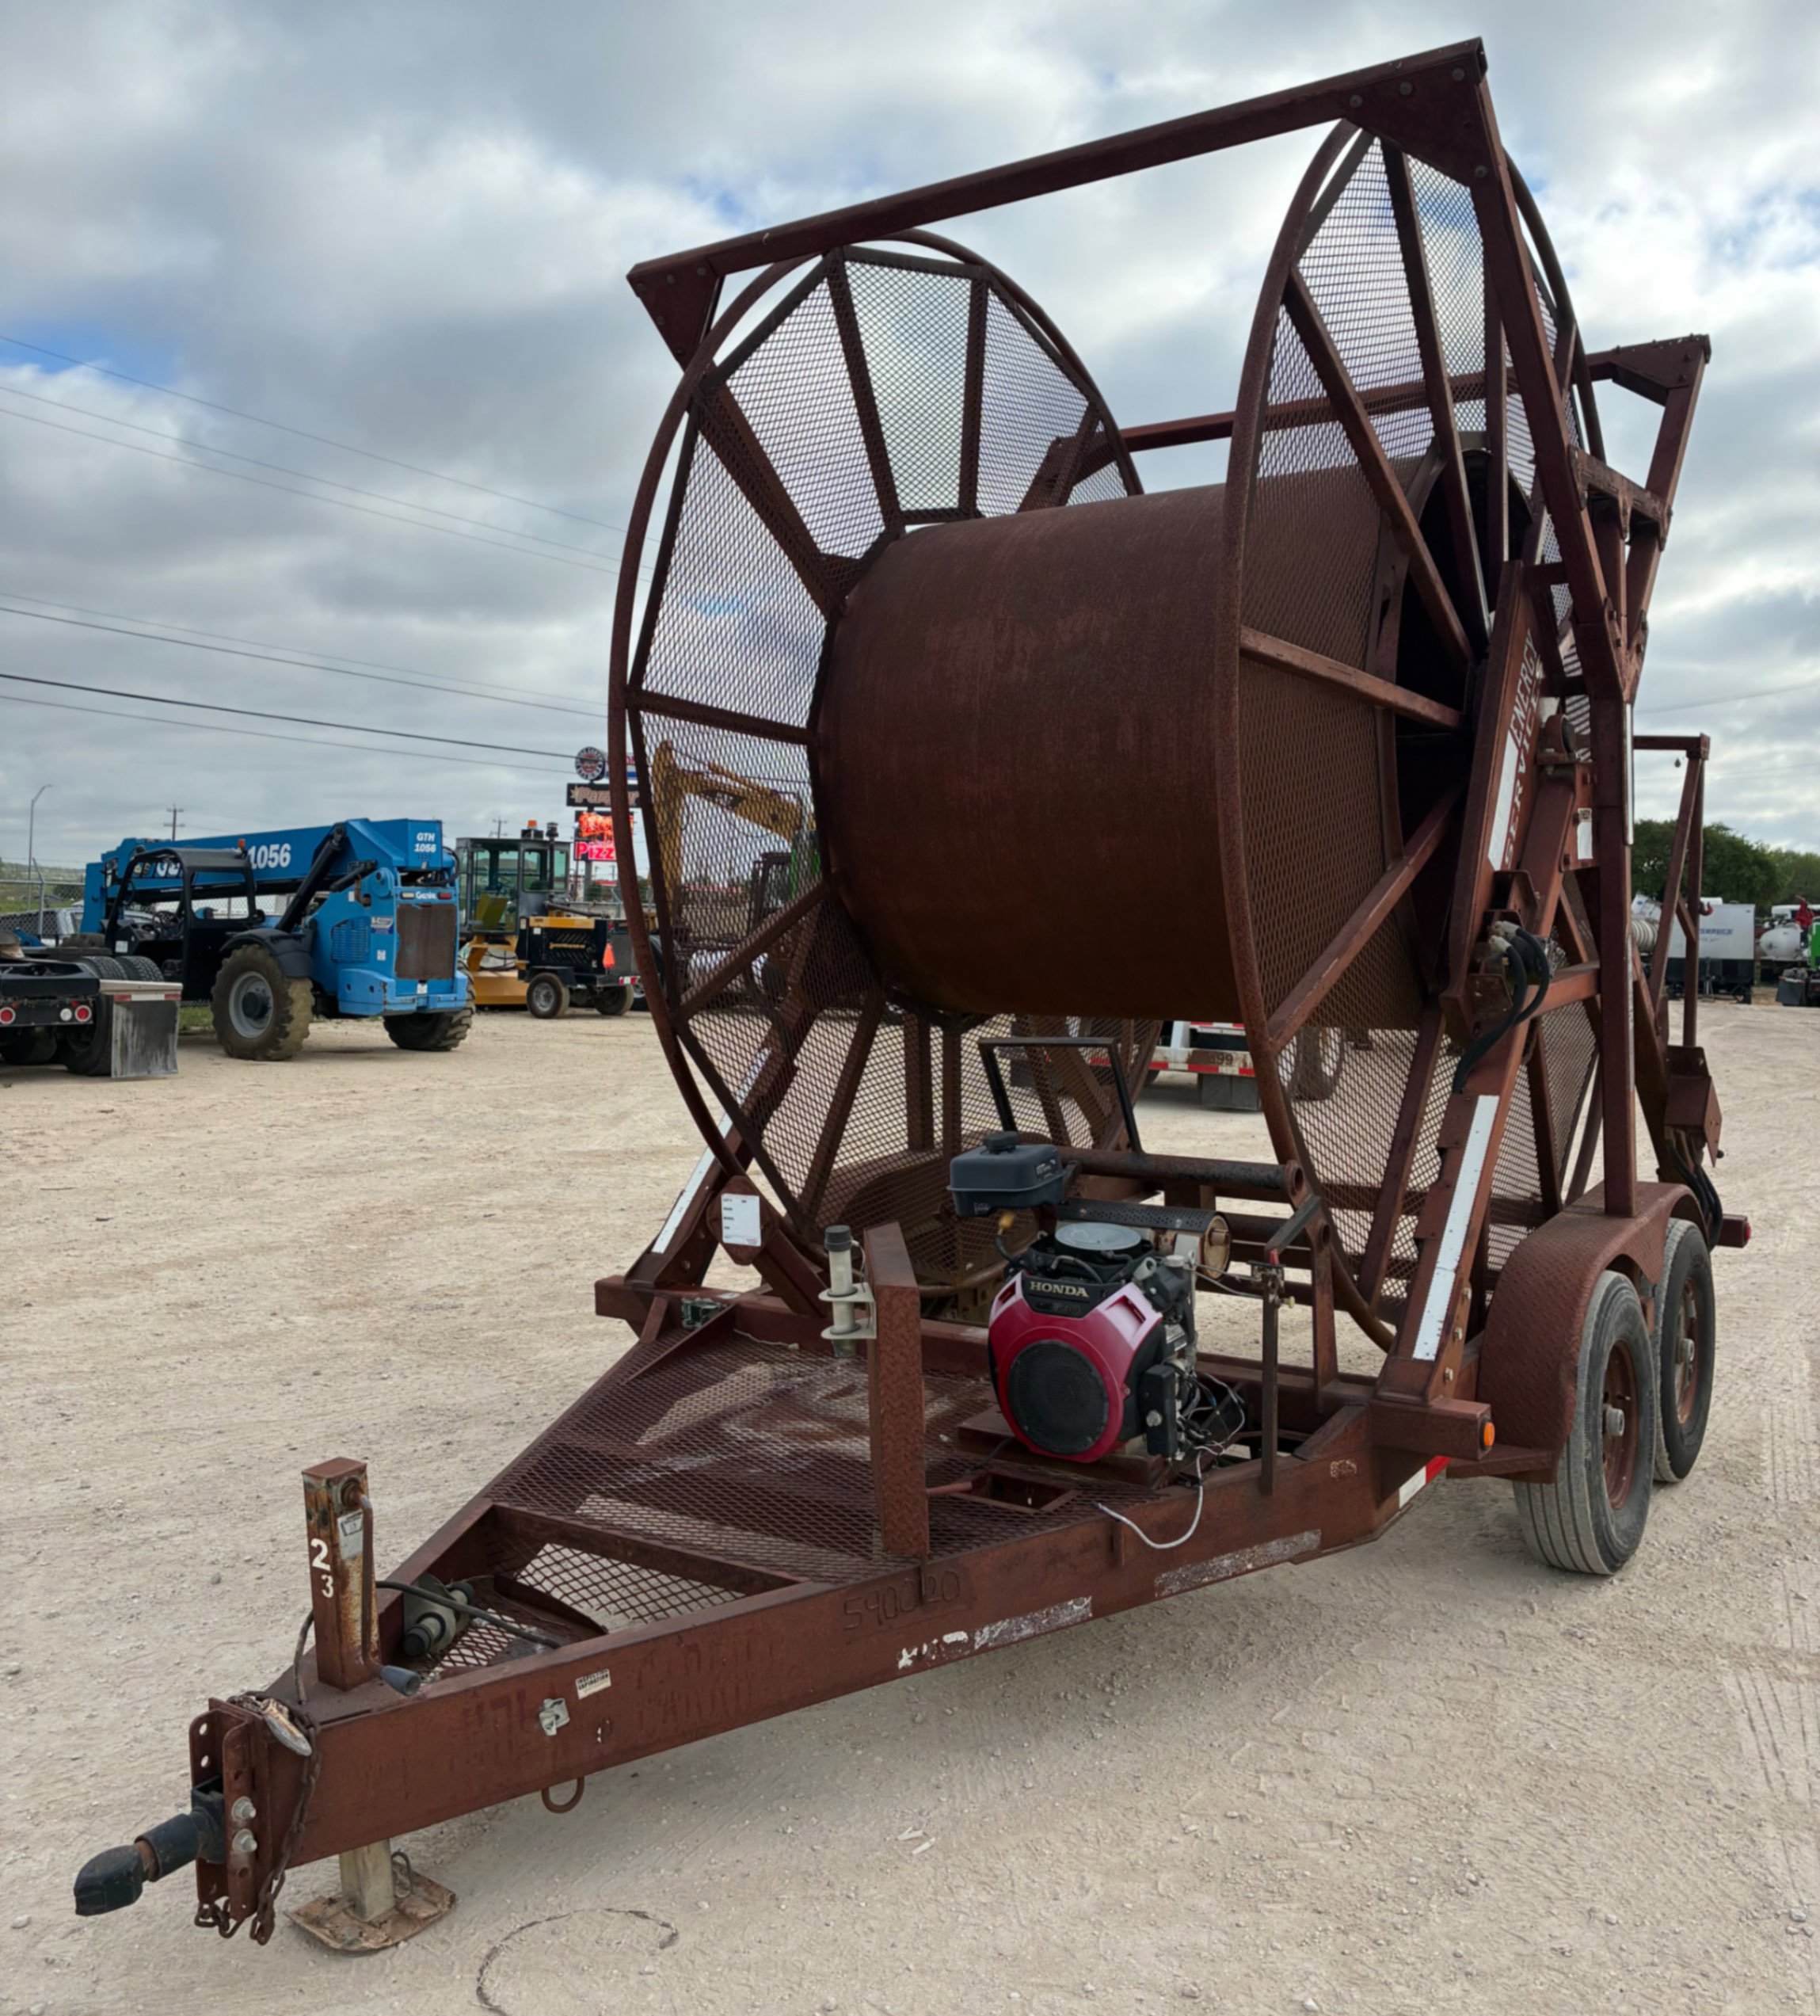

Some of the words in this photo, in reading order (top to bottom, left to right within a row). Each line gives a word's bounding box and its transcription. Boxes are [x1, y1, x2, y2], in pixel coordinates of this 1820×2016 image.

[1510, 628, 1536, 748] ENERGY
[413, 843, 436, 853] 1056
[417, 833, 435, 842] GTH
[248, 844, 291, 870] 1056
[576, 841, 616, 860] Pizz
[1030, 1281, 1090, 1298] HONDA
[310, 1538, 331, 1572] 2
[321, 1574, 334, 1599] 3
